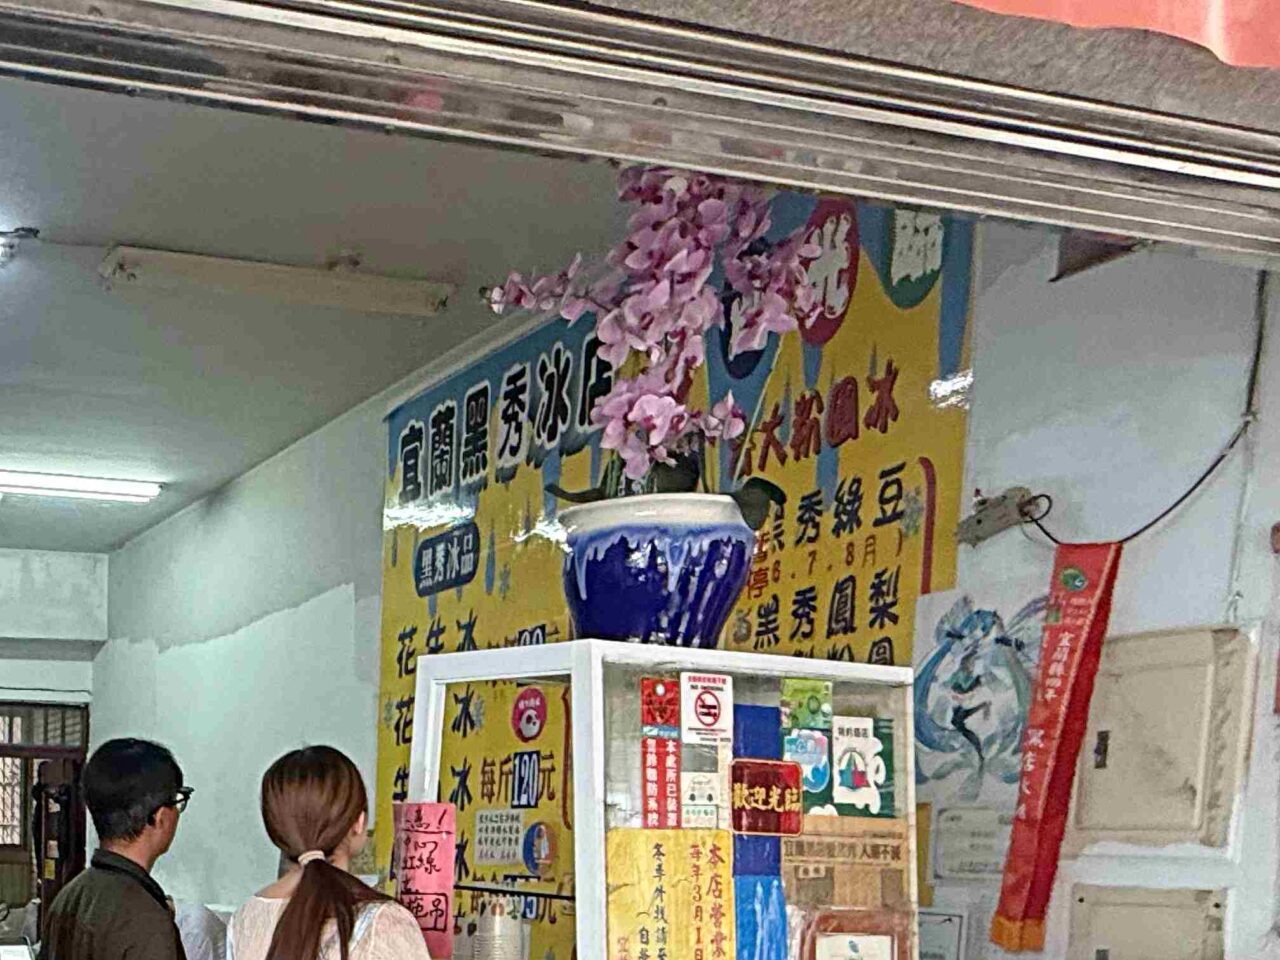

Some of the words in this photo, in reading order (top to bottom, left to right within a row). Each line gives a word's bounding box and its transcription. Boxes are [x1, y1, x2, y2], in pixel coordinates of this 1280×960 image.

[419, 532, 474, 588] 黑秀冰品
[732, 781, 802, 812] 歡迎光臨
